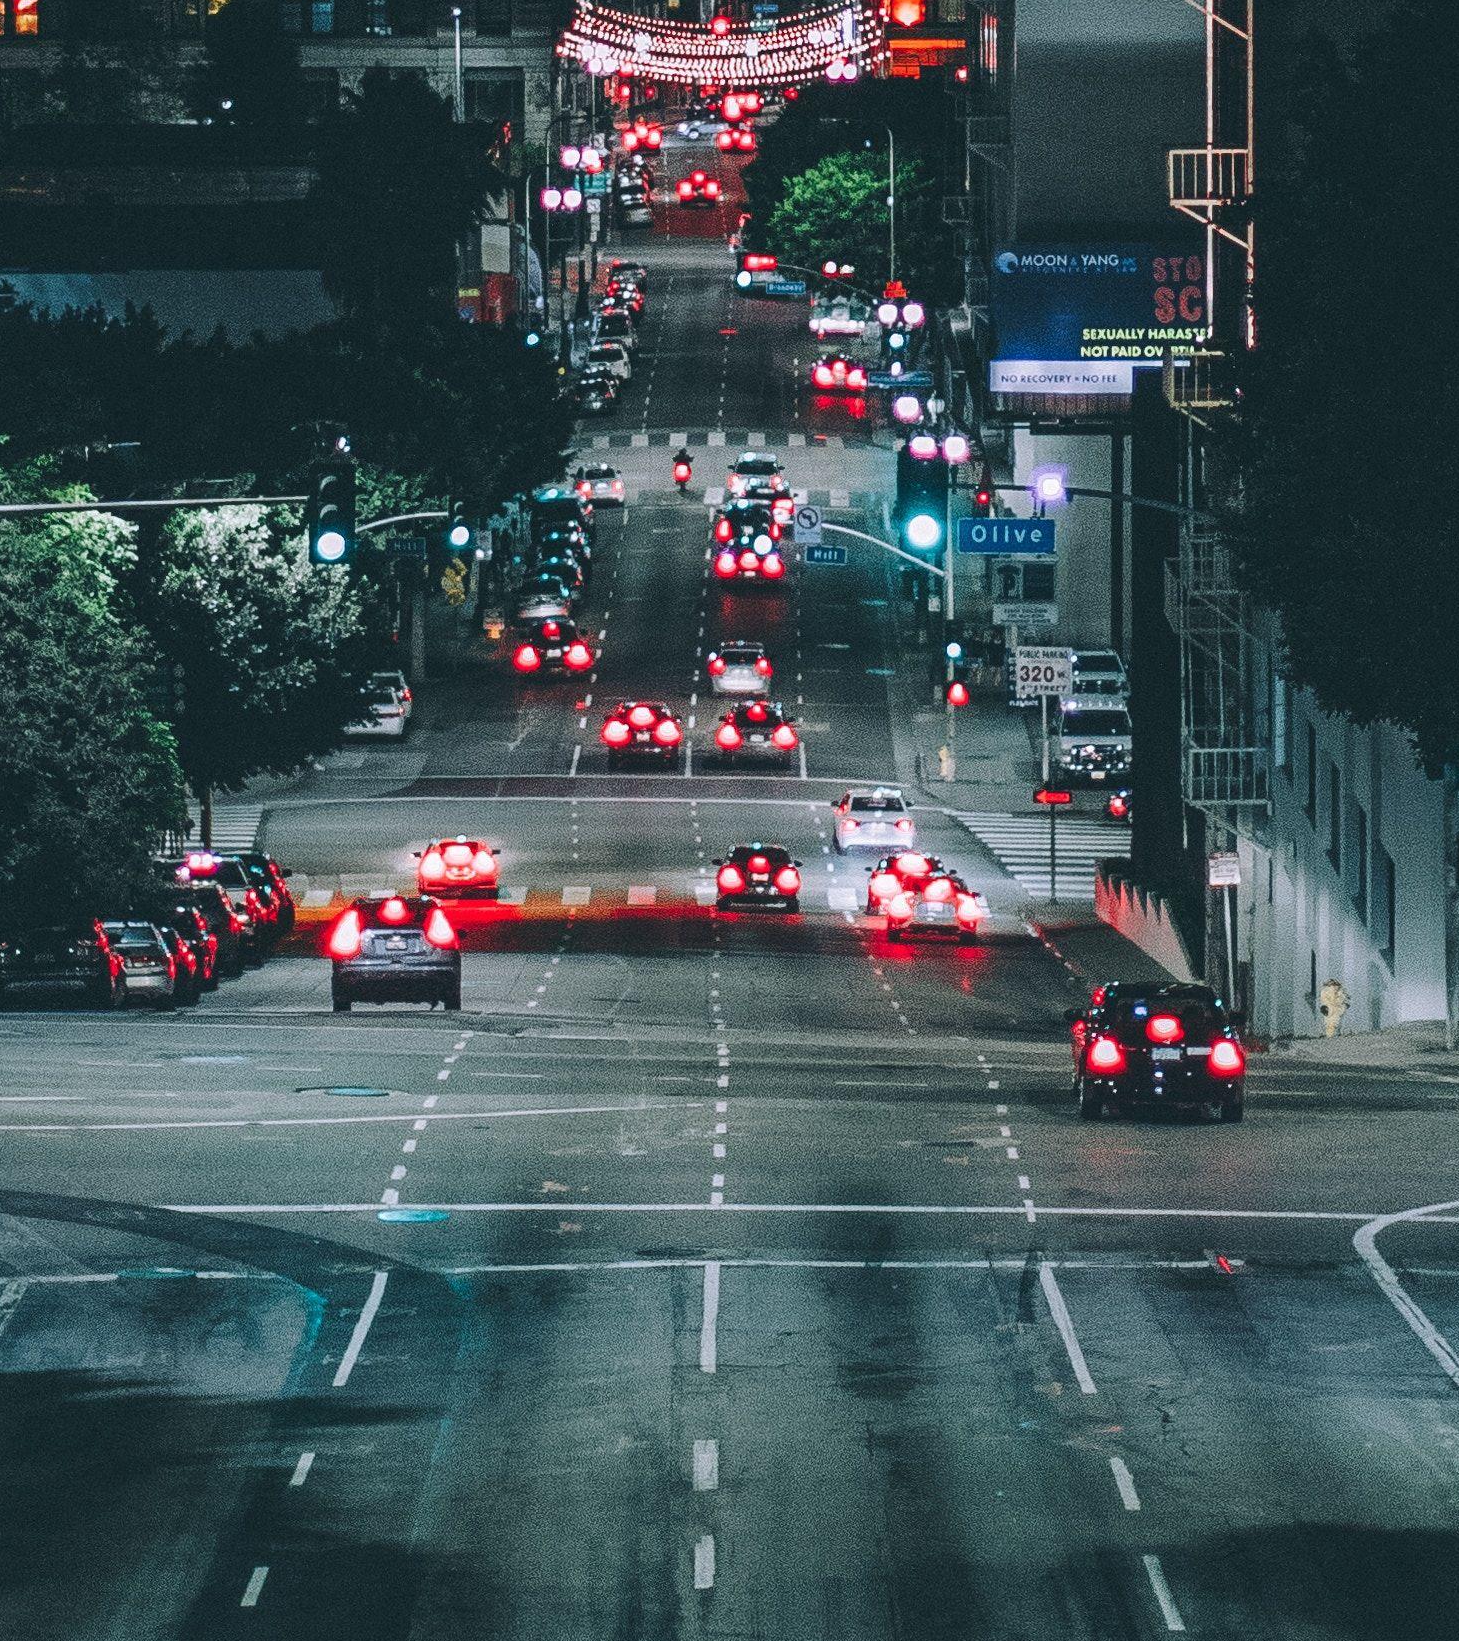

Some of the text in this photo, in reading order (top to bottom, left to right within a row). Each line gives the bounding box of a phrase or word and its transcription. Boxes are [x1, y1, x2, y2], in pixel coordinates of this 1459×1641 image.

[1021, 255, 1068, 266] MOON
[1081, 254, 1119, 266] YANG
[1082, 328, 1144, 340] SEXUALLY
[1080, 346, 1109, 357] NOT
[1111, 346, 1141, 357] PAID
[1001, 375, 1018, 383] NO
[1020, 375, 1072, 383] RECOVERY
[1082, 375, 1099, 383] NO
[1102, 375, 1117, 383] FEE
[971, 524, 1042, 543] Olive
[814, 550, 838, 560] Hill
[1020, 665, 1055, 682] 320
